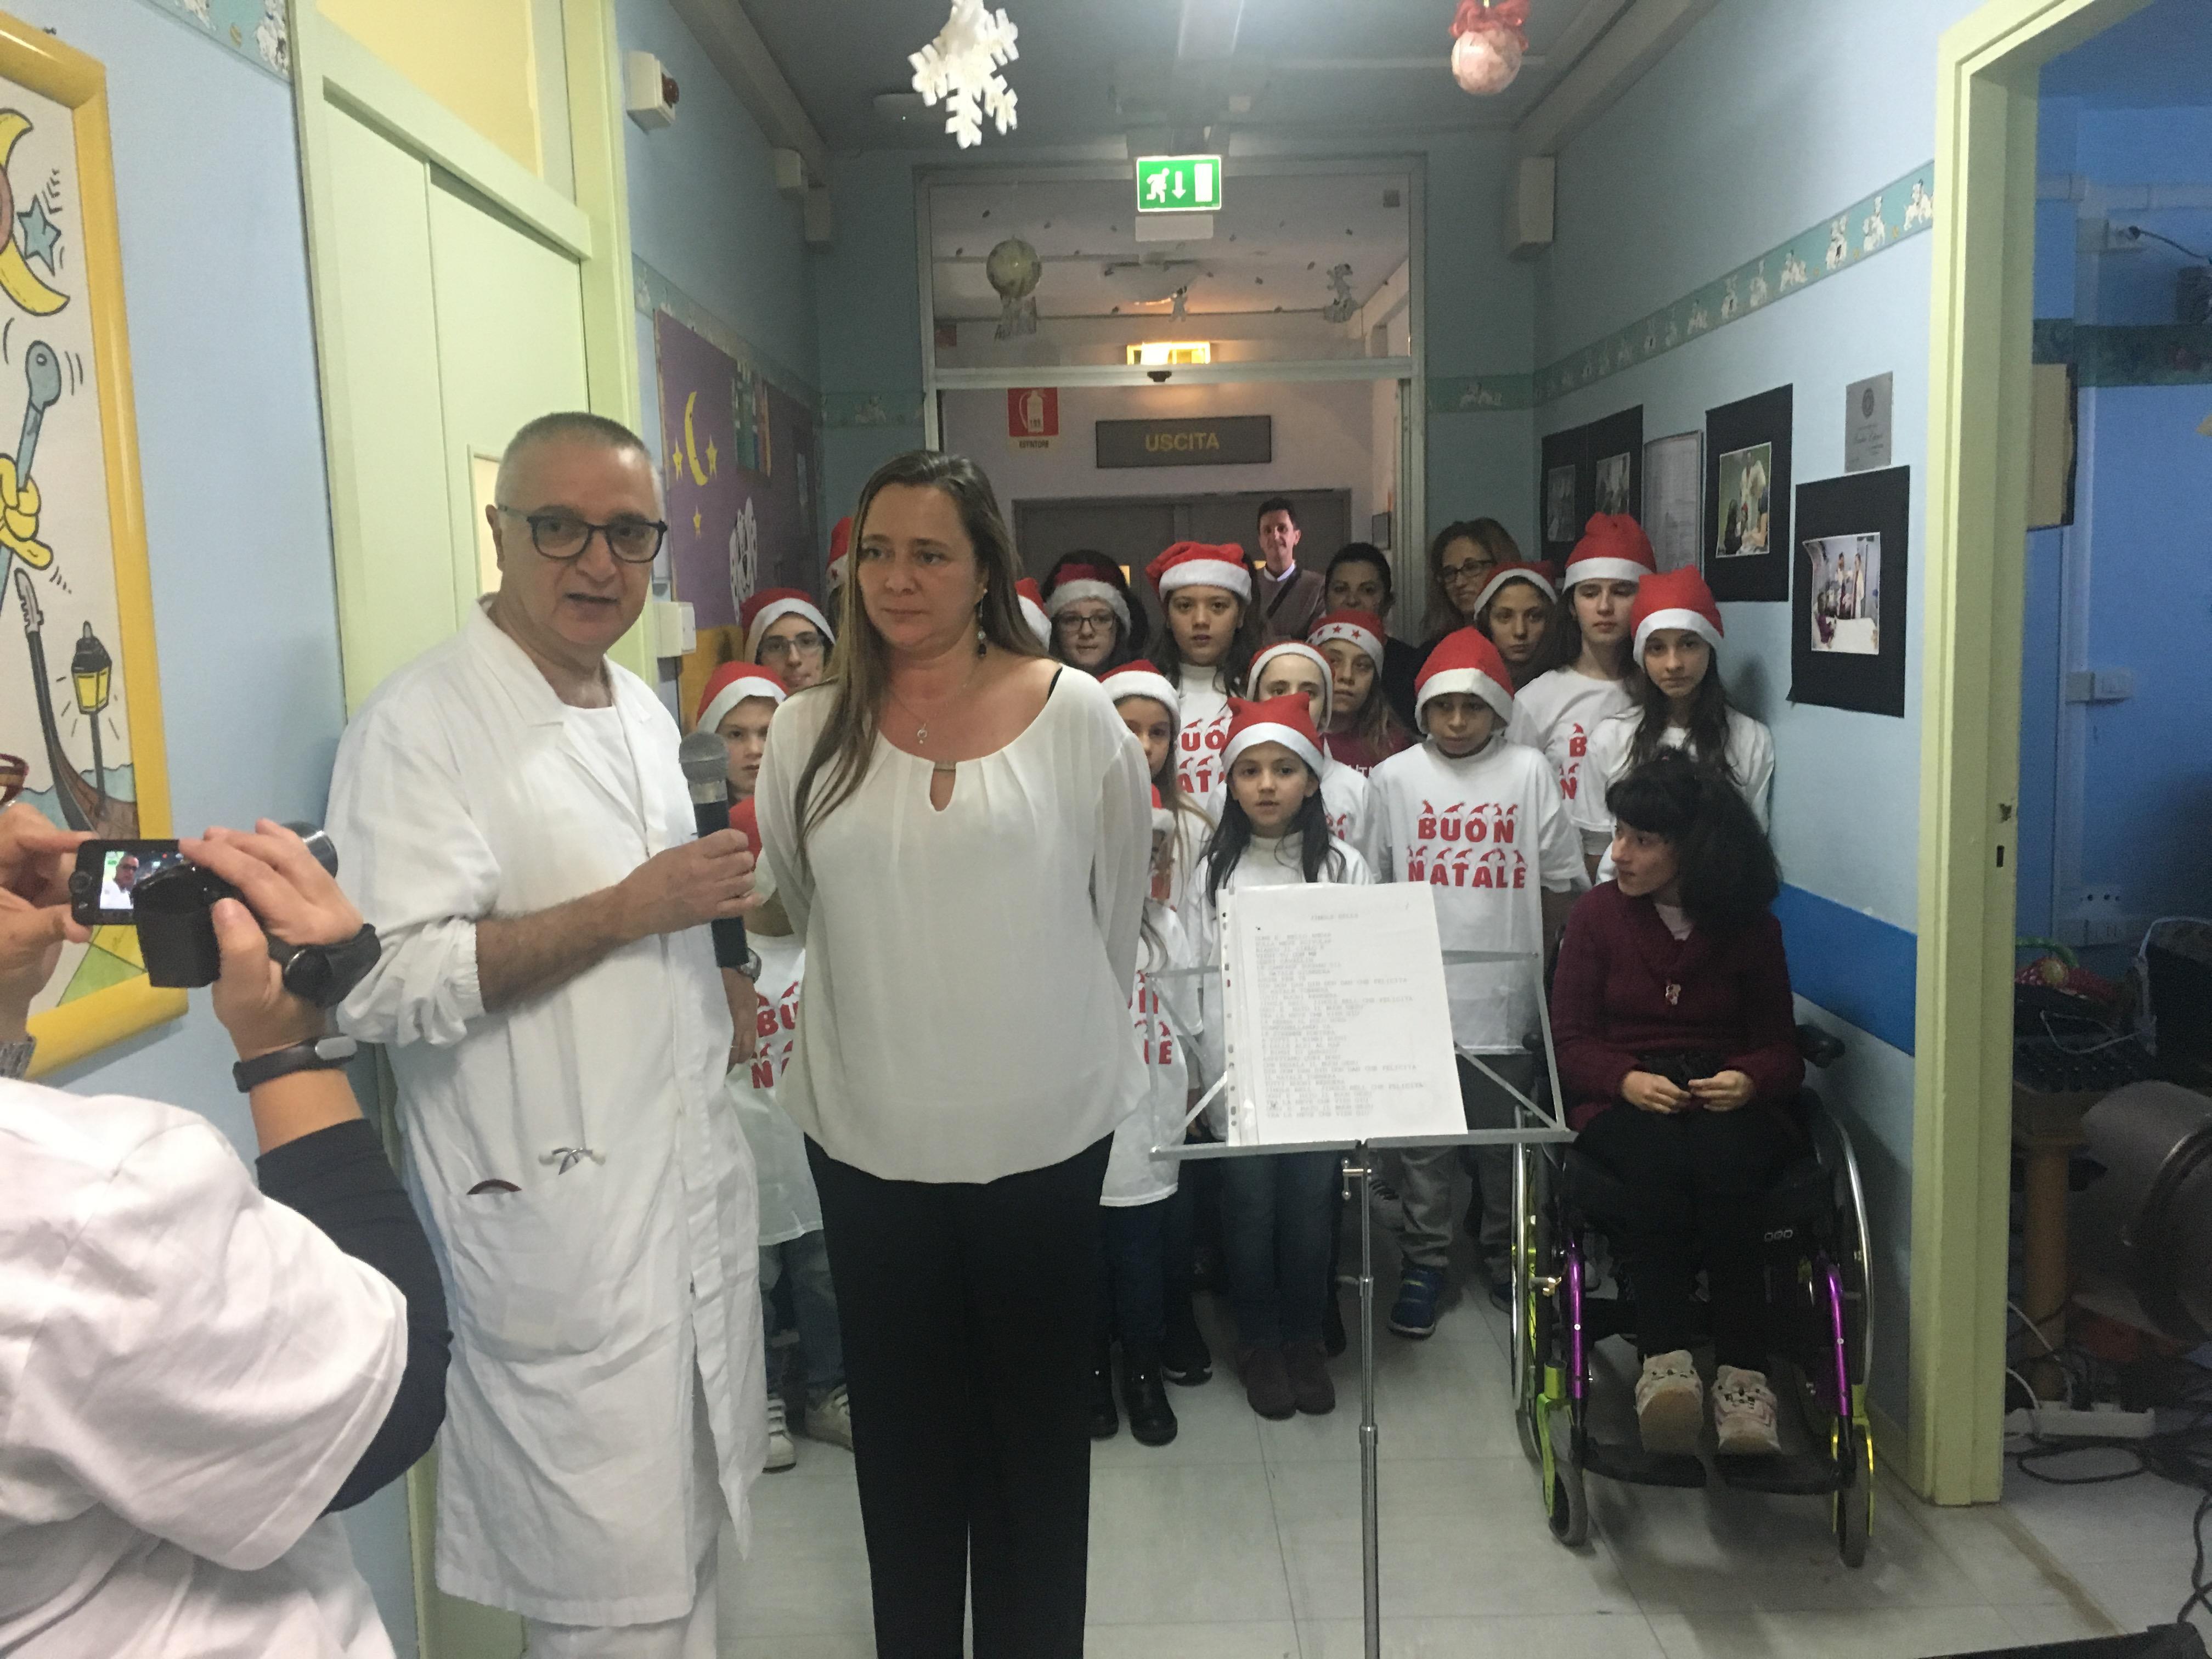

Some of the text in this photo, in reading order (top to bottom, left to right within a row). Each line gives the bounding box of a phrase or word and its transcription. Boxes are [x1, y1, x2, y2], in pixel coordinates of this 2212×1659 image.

[1146, 432, 1220, 452] USCITA
[1418, 812, 1515, 844] BUON
[1408, 856, 1527, 889] NATALE
